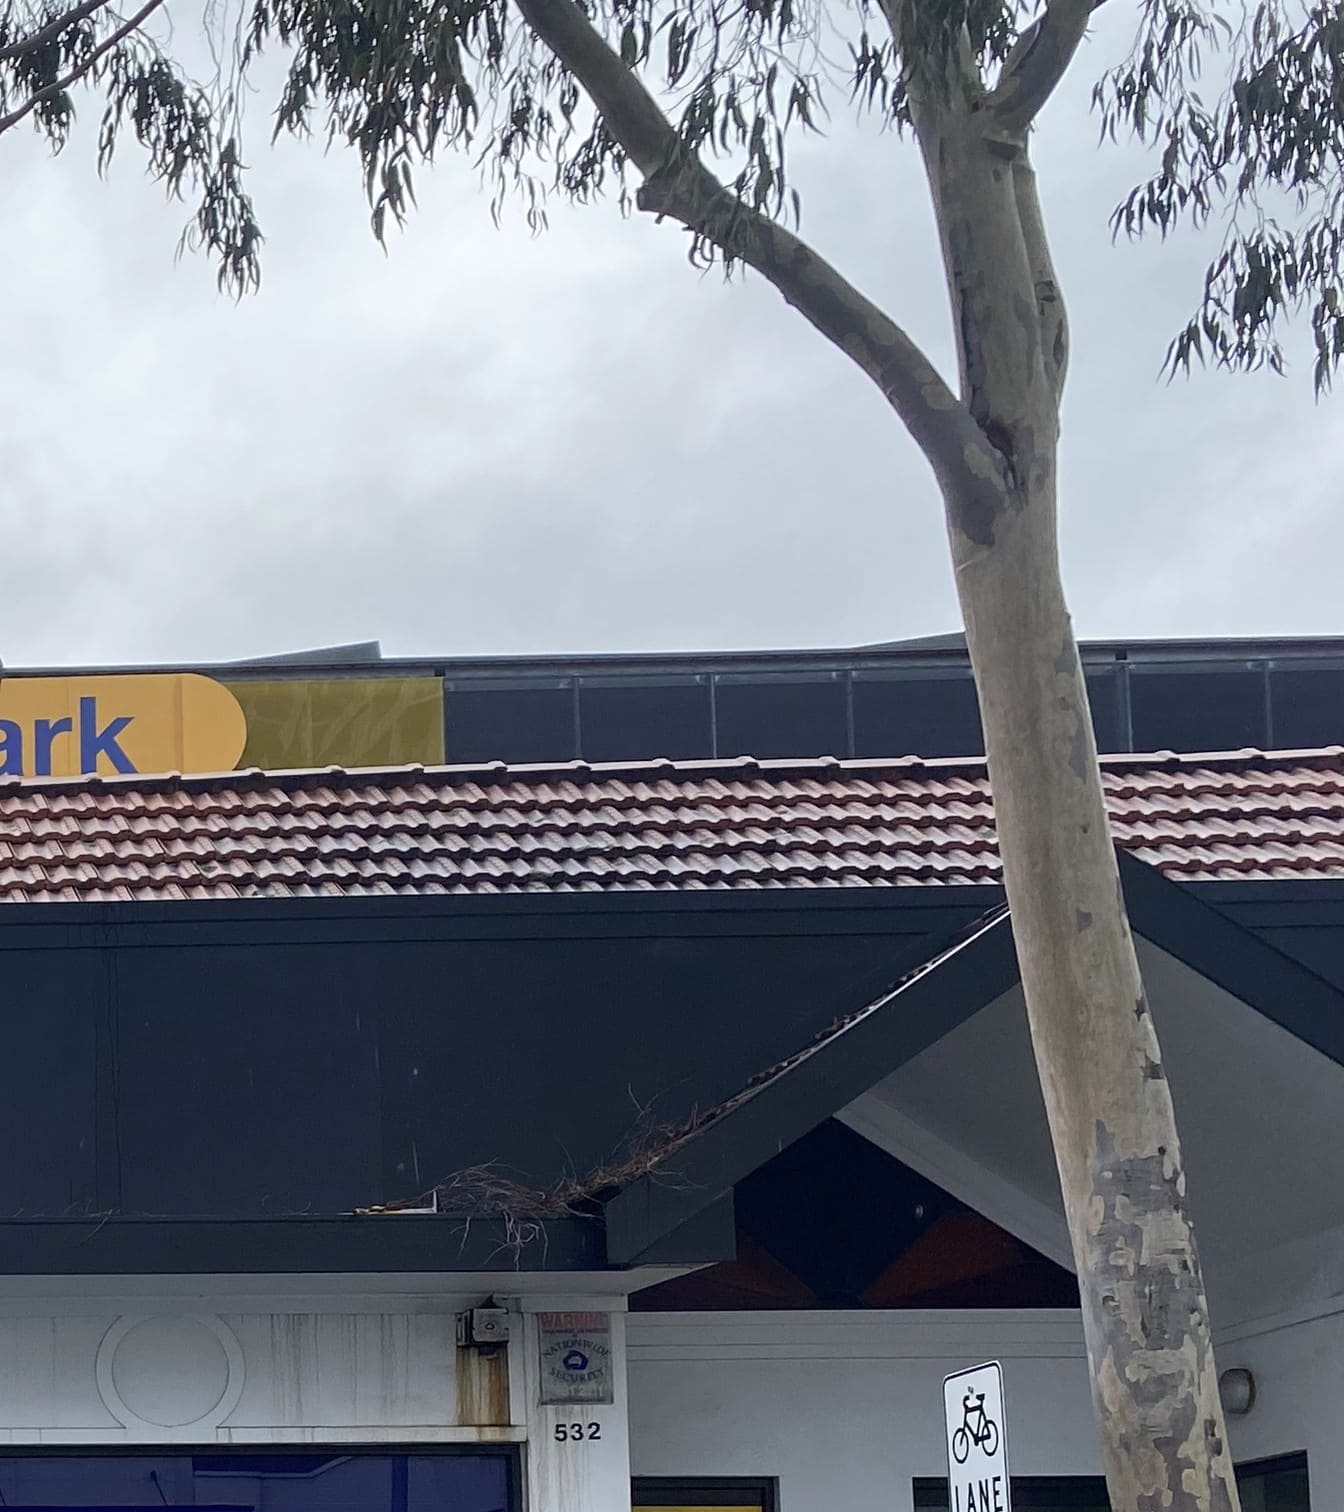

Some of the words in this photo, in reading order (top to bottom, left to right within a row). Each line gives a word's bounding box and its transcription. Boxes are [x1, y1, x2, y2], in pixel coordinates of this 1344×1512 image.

[542, 1338, 610, 1358] NATIONWIDE
[549, 1366, 605, 1383] SECURITY
[554, 1422, 601, 1442] 532
